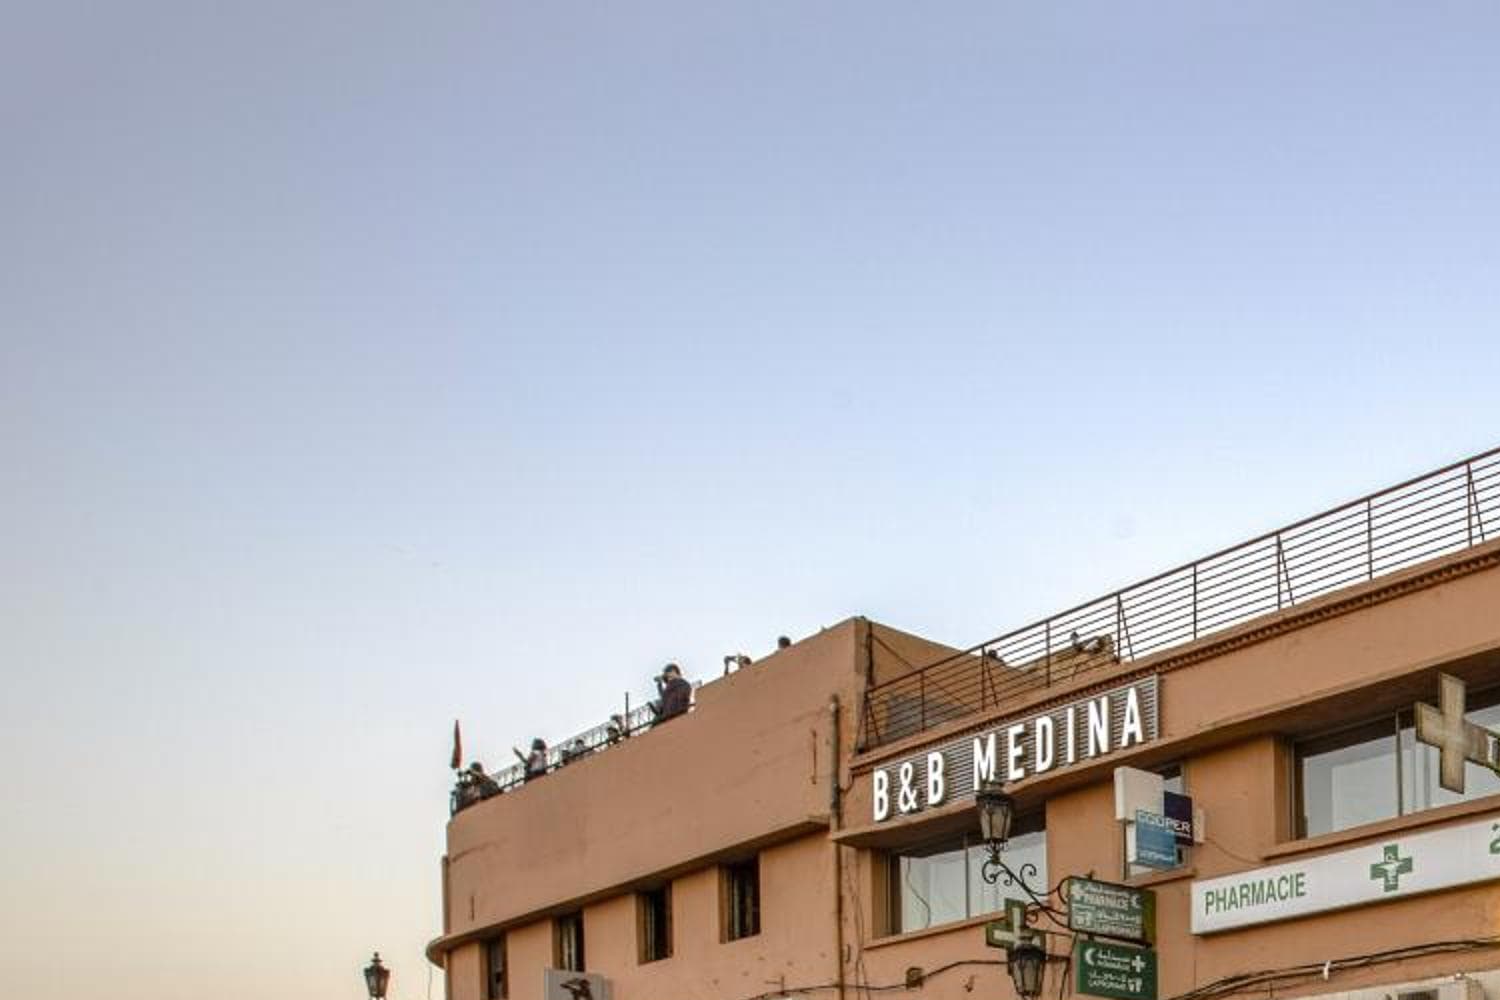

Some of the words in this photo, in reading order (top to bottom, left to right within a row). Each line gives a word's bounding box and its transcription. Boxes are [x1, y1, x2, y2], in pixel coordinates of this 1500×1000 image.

[873, 751, 945, 822] B&B
[973, 687, 1143, 791] MEDINA
[1205, 873, 1306, 915] PHARMACIE
